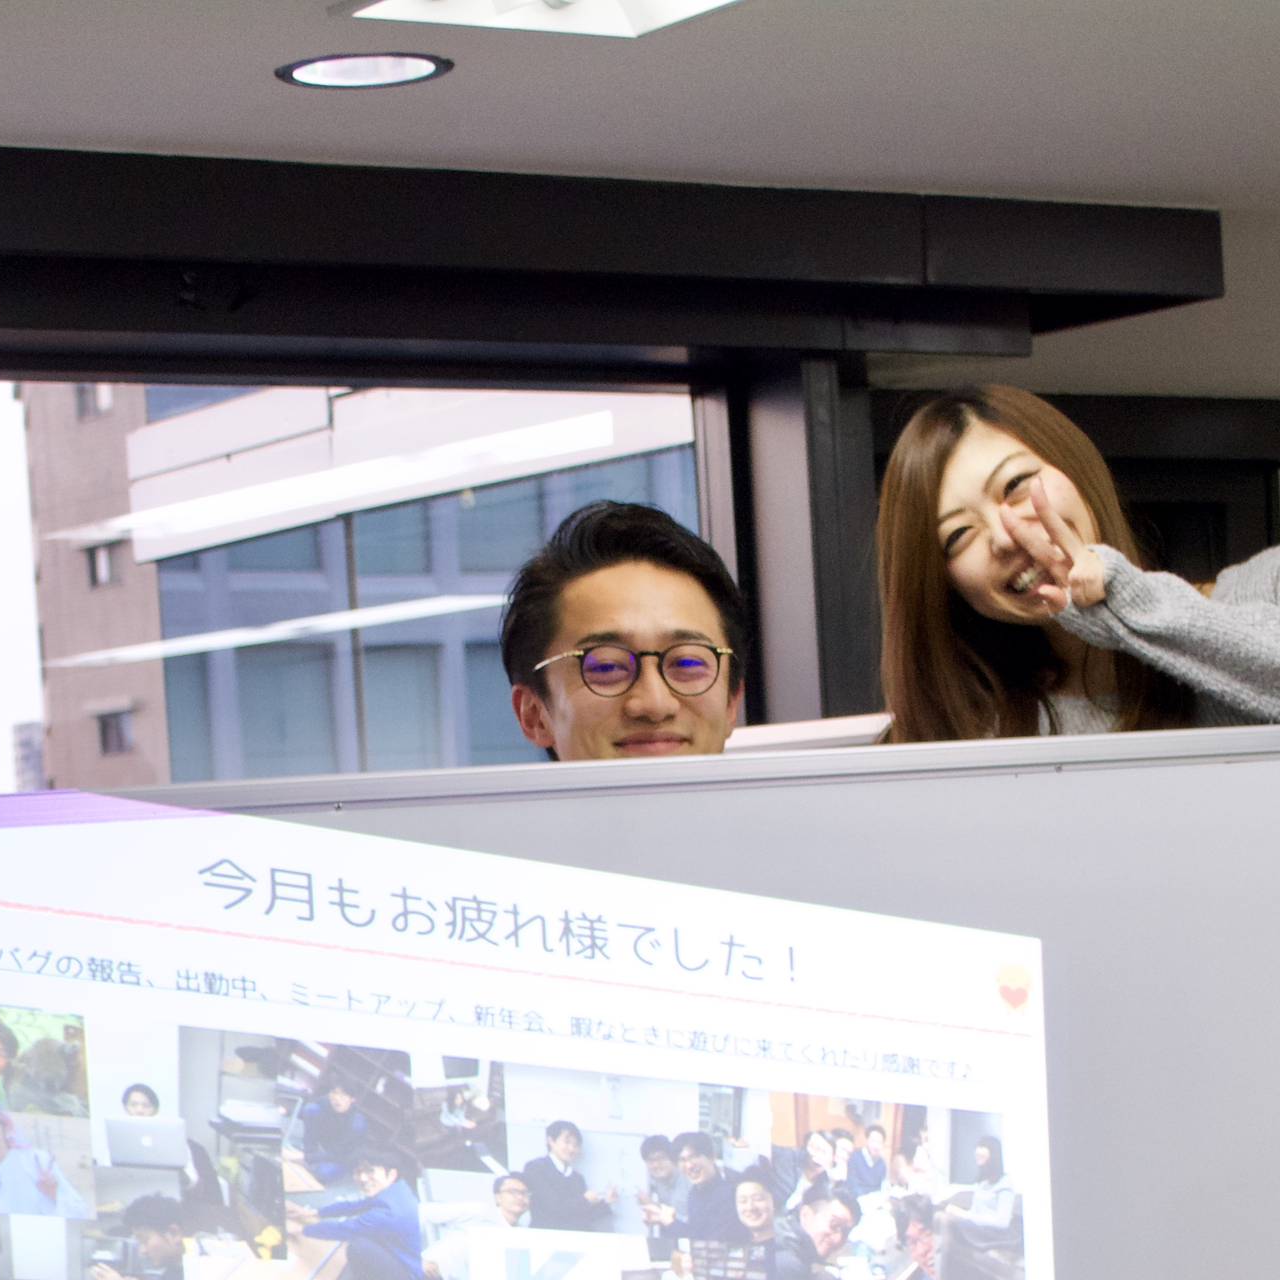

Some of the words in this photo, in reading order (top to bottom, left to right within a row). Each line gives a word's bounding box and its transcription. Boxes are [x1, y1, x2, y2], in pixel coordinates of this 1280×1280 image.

[197, 857, 798, 983] 今月もお疲れ様でした！
